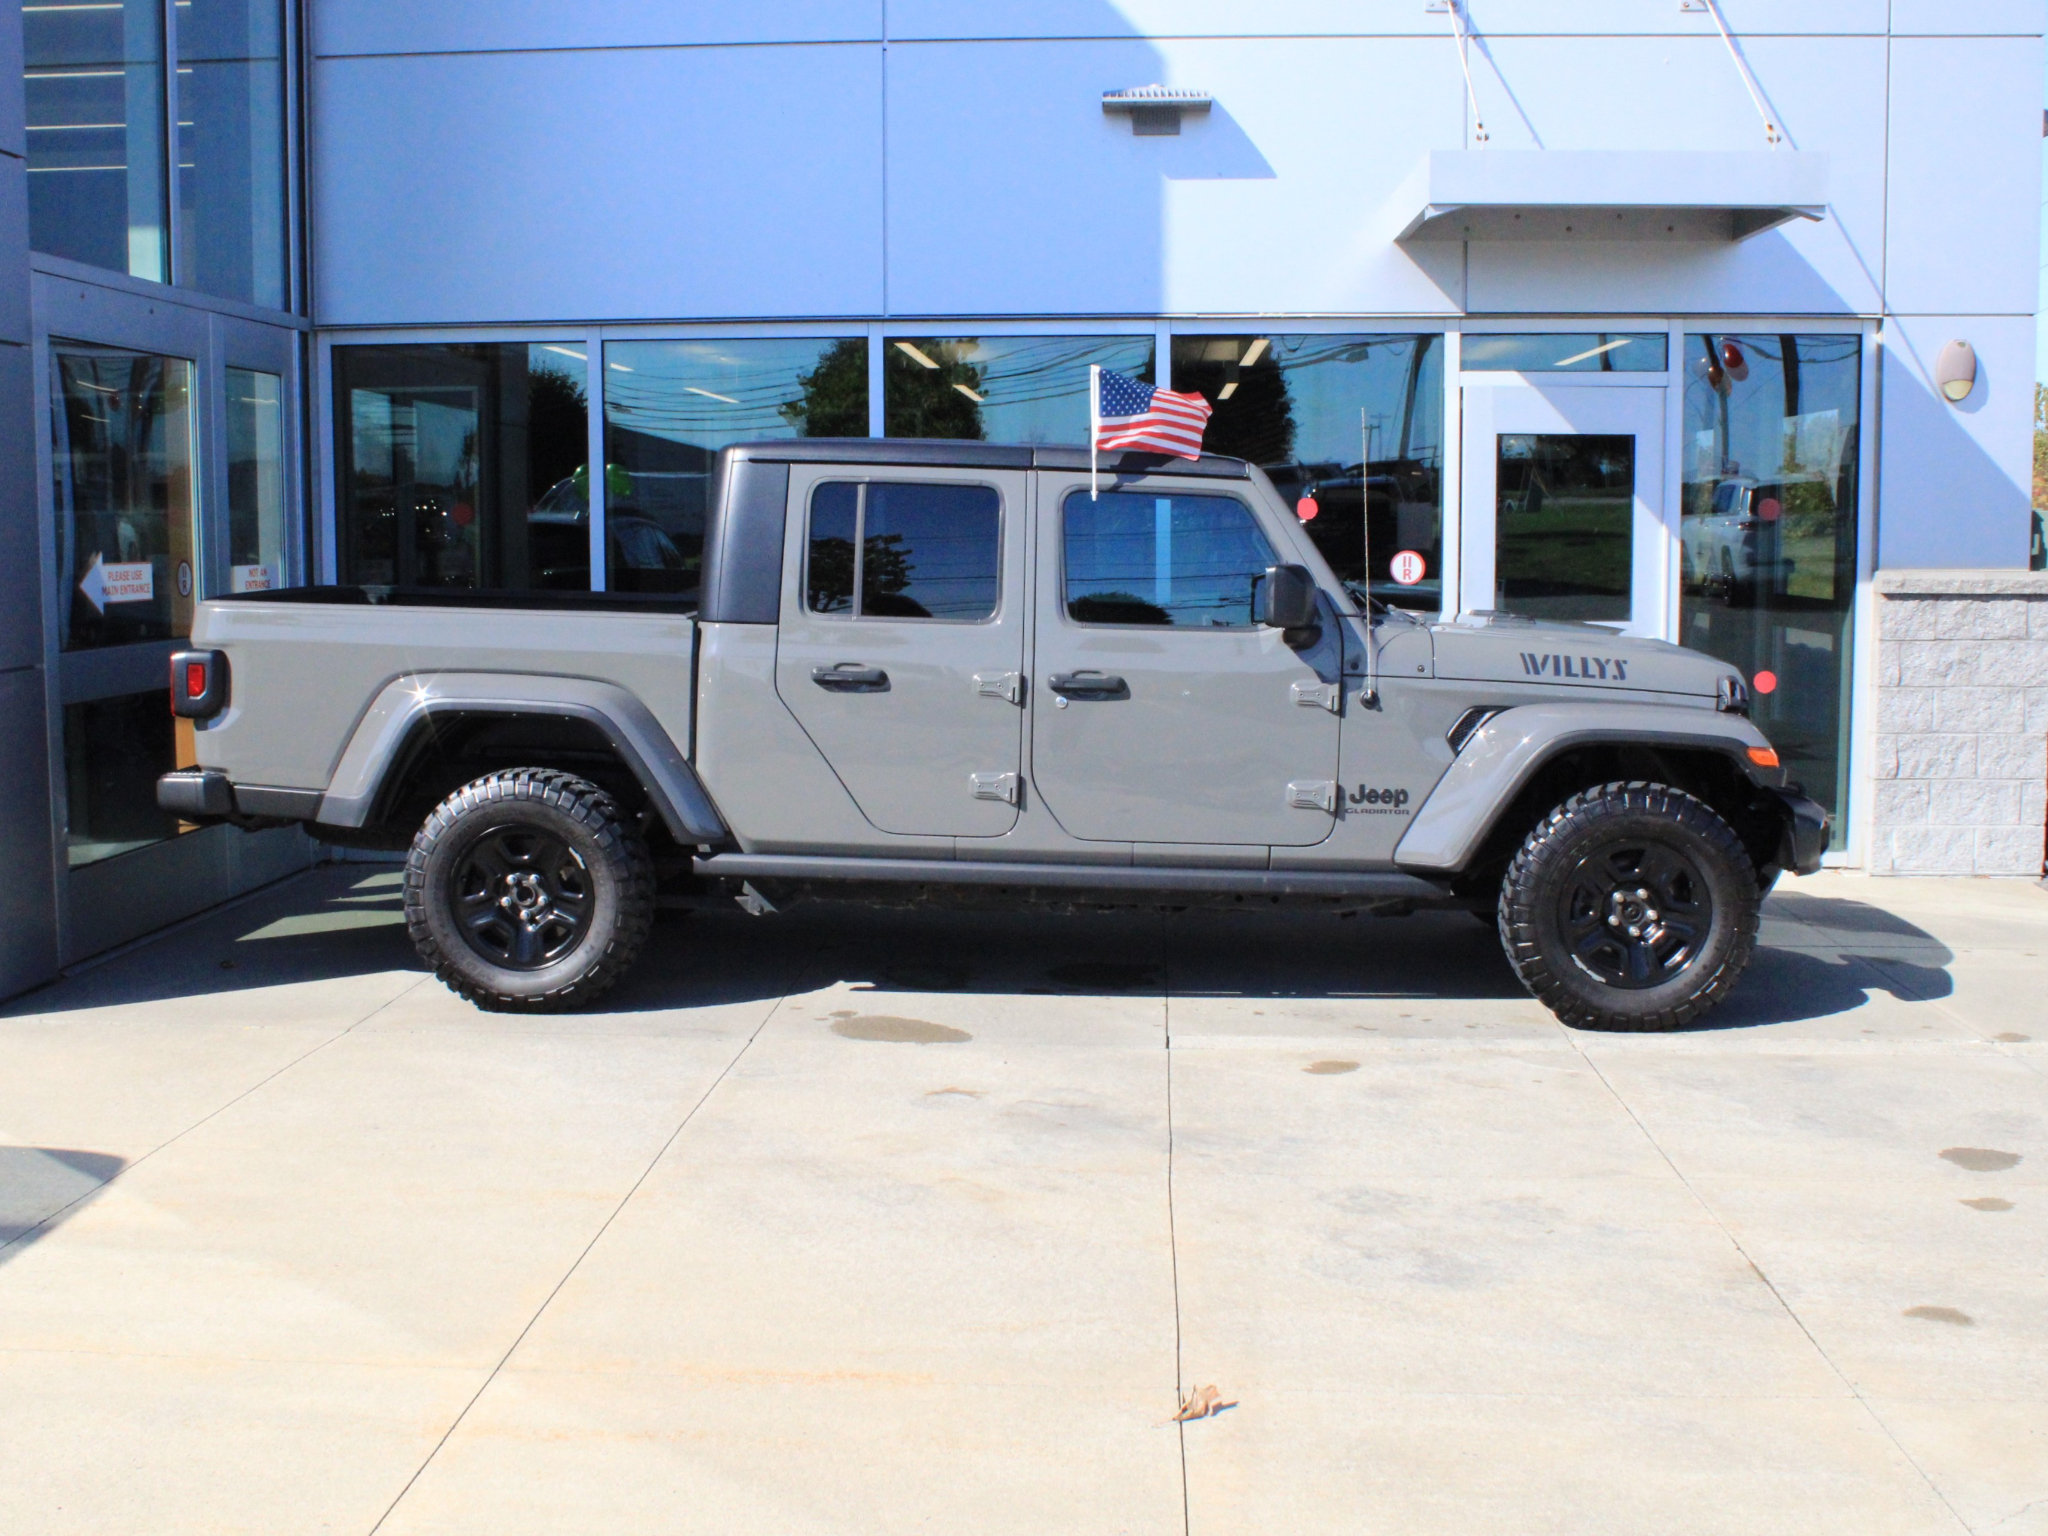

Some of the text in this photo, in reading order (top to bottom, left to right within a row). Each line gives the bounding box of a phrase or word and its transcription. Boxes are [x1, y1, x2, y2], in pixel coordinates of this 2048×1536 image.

[108, 569, 143, 582] PLEASE USE
[249, 567, 268, 577] NOT AN
[102, 583, 150, 596] MAIN ENTRANCE
[245, 579, 271, 590] ENTRANCE
[1519, 652, 1628, 681] WILLYS
[1349, 784, 1409, 808] Jeep
